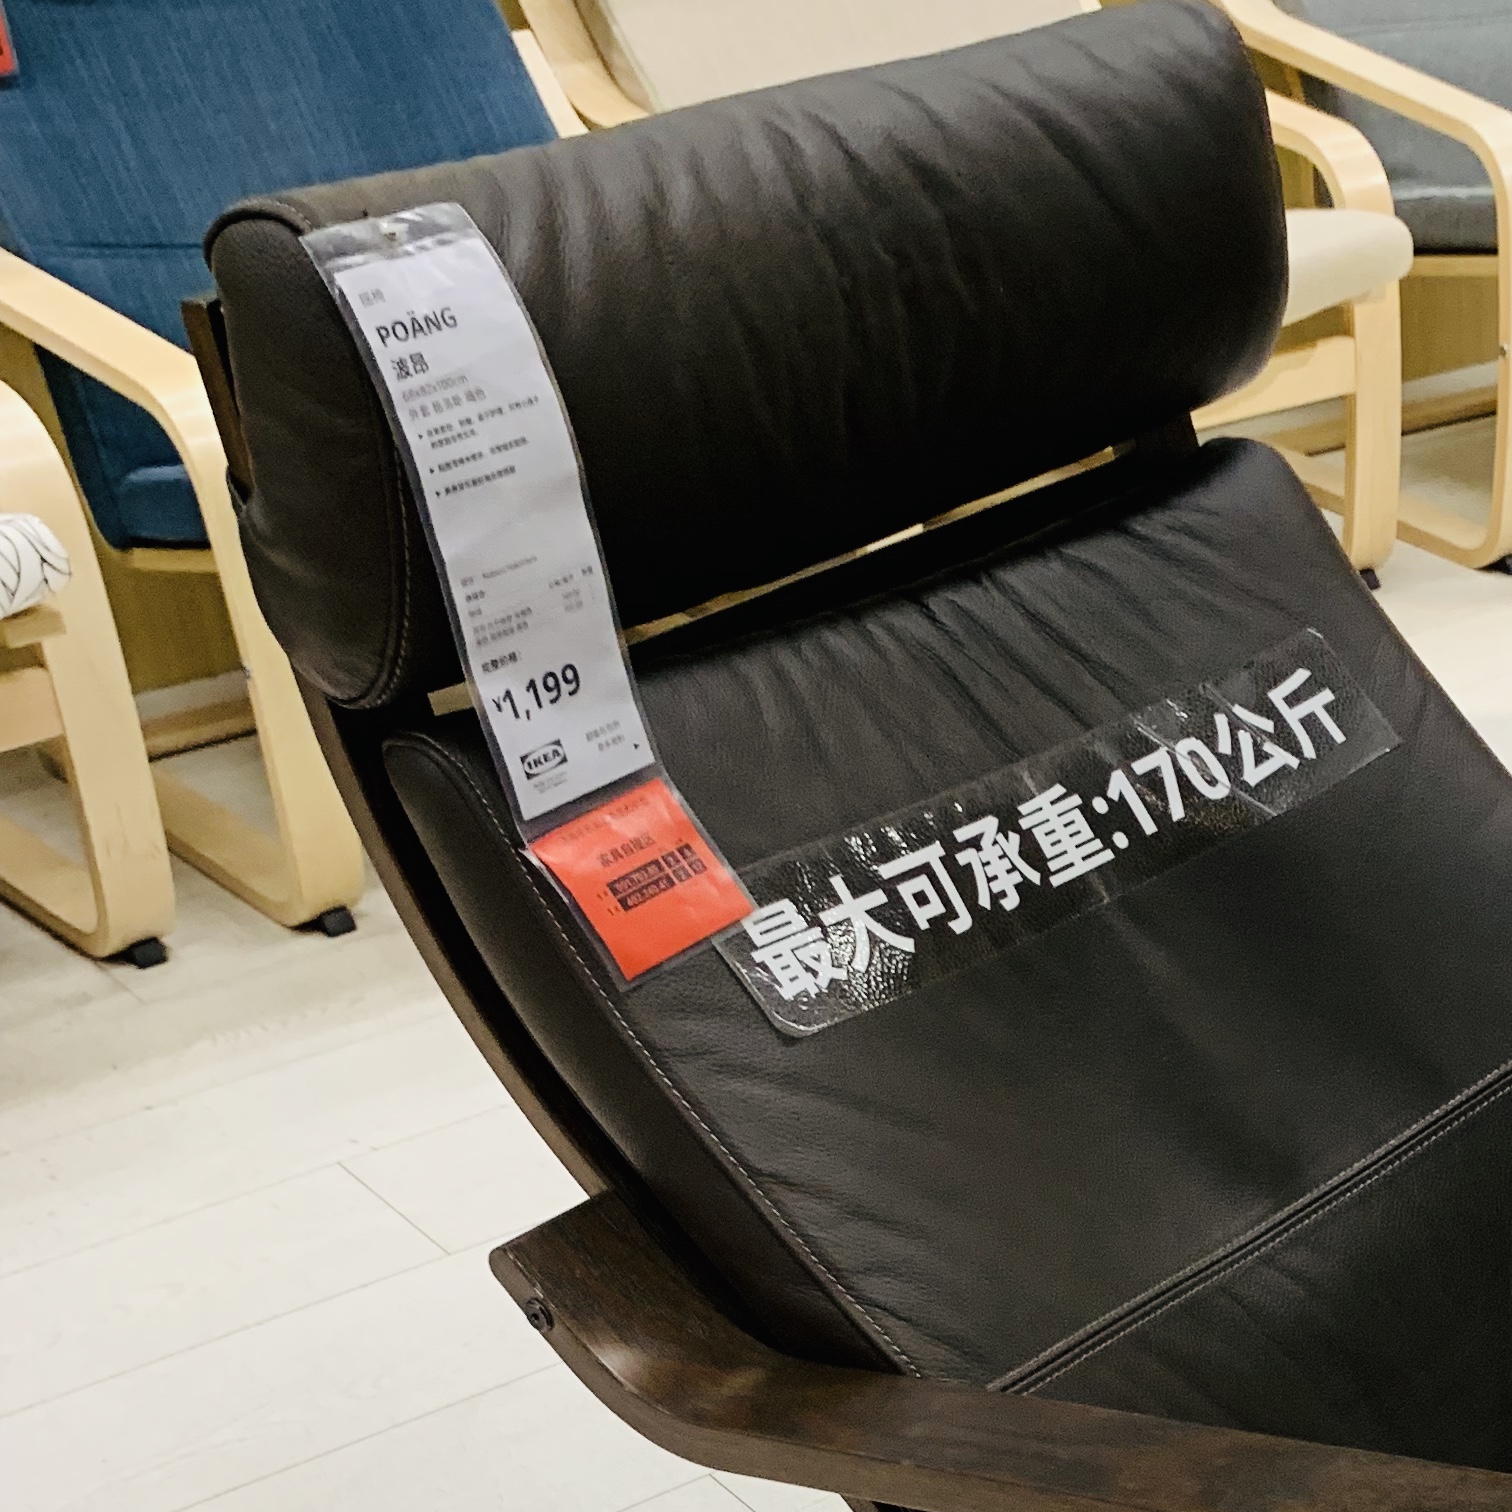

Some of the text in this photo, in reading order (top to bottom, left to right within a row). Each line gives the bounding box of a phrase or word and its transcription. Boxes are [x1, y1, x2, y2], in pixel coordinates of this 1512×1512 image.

[375, 307, 458, 347] POÄNG
[391, 352, 429, 381] 波昂
[492, 663, 580, 721] ¥1,199
[526, 748, 562, 771] IKEA
[742, 667, 1347, 1001] 最大可承重:170公斤
